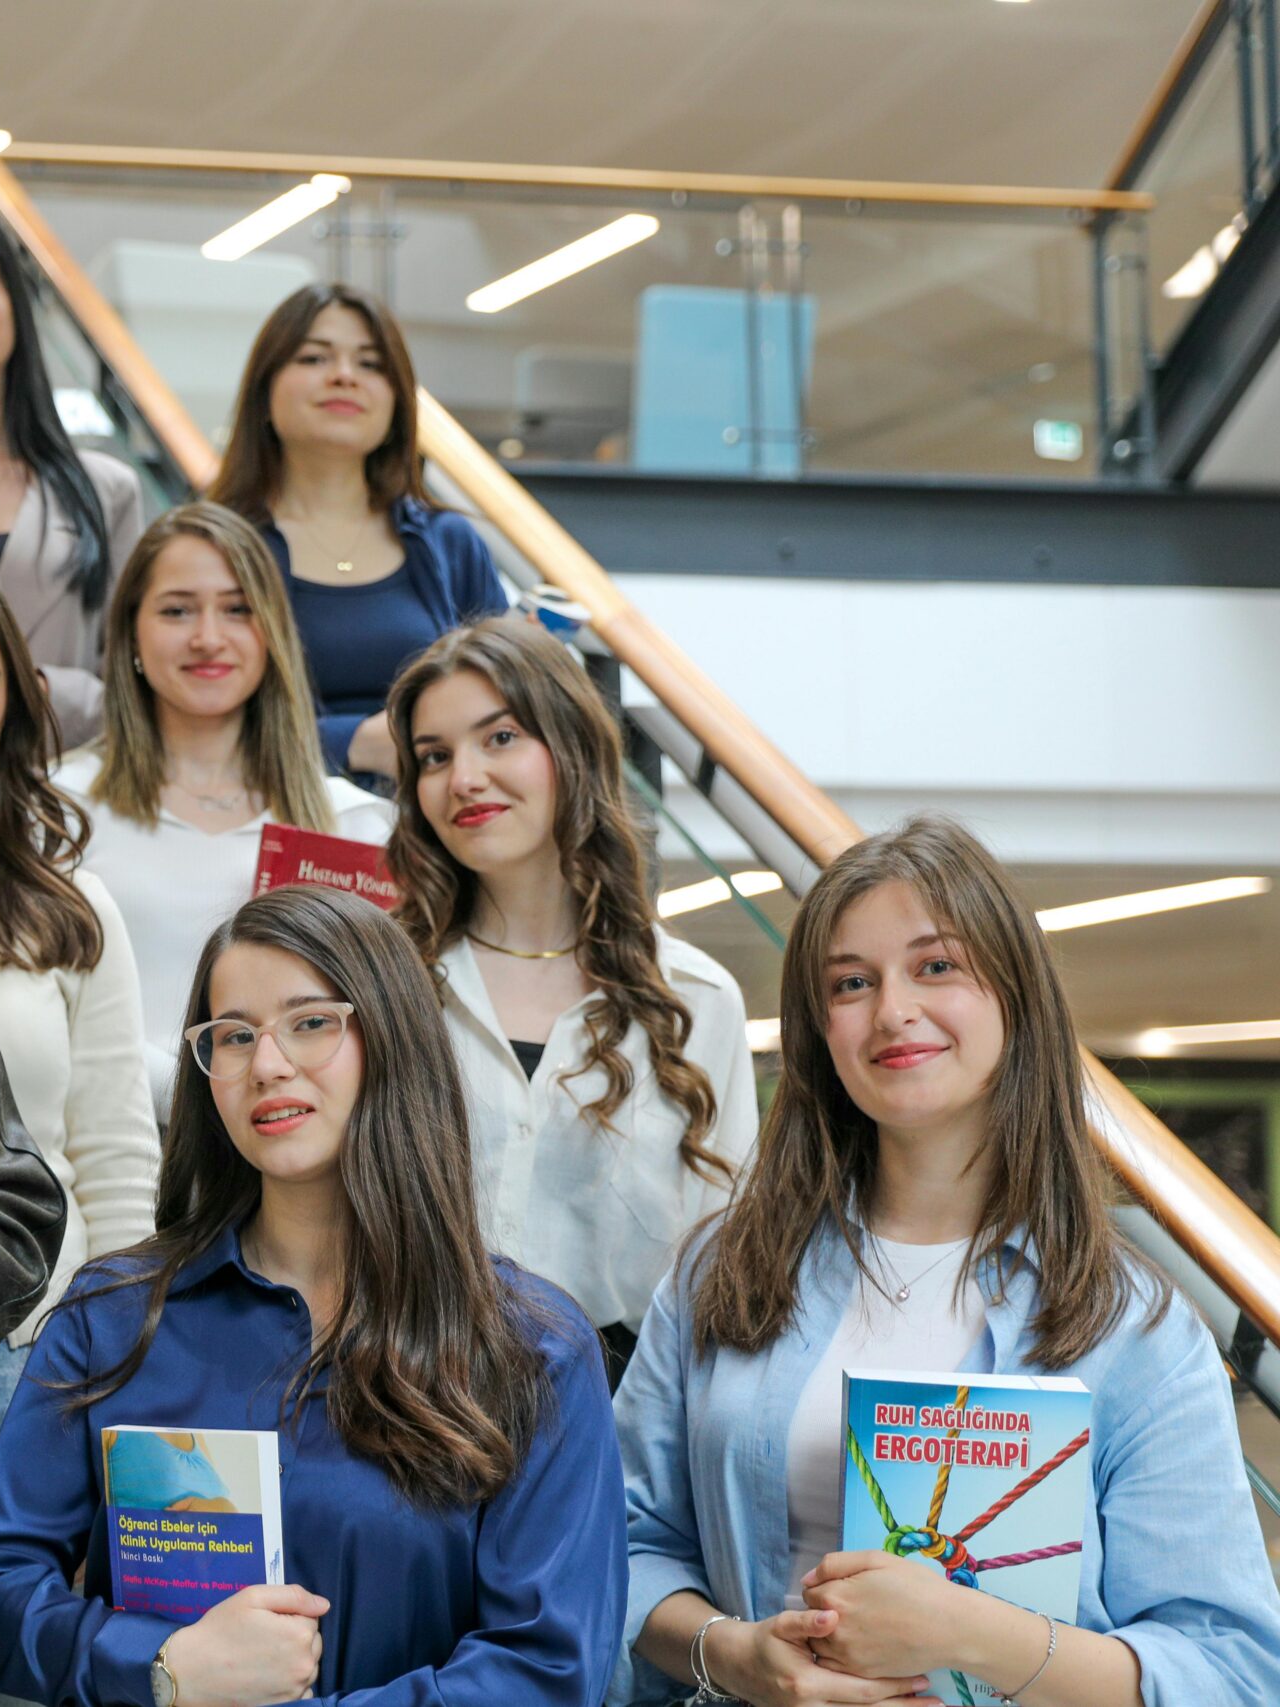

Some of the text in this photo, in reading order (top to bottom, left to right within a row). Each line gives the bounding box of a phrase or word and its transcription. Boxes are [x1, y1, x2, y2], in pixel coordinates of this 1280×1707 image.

[875, 1403, 1031, 1432] RUH SAĞLIĞINDA
[874, 1434, 1030, 1468] ERGOTERAPİ
[118, 1514, 218, 1537] Öğrenci Ebeler için
[120, 1534, 253, 1554] Klinik Uygulama Rehberi
